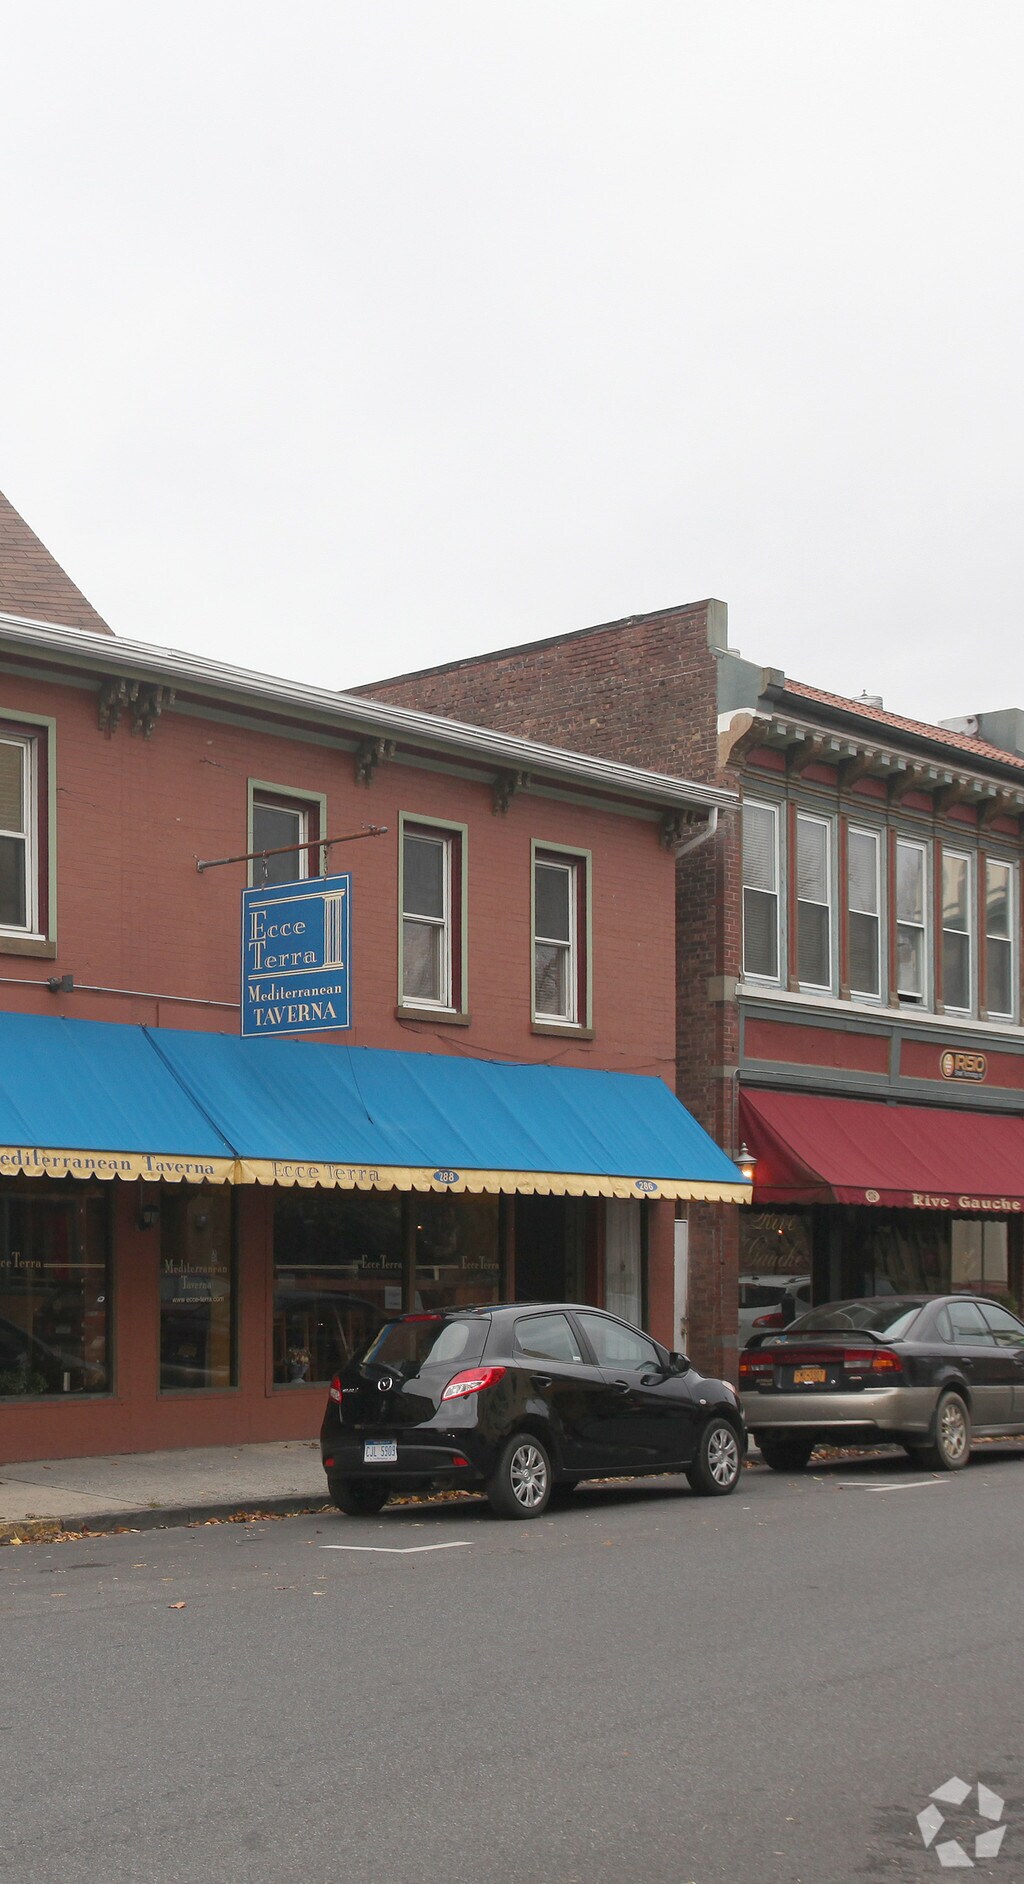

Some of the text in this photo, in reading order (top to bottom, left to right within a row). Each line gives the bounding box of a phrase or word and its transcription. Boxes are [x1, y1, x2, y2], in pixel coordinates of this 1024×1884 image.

[249, 910, 306, 941] Ecce
[248, 940, 317, 971] Terra
[248, 983, 342, 1003] Mediterranean
[254, 1000, 337, 1026] TAVERNA
[142, 1155, 215, 1175] Taverna
[272, 1161, 380, 1182] Ecce Terra
[439, 1171, 455, 1182] 288
[912, 1193, 1021, 1210] Rive Gauche
